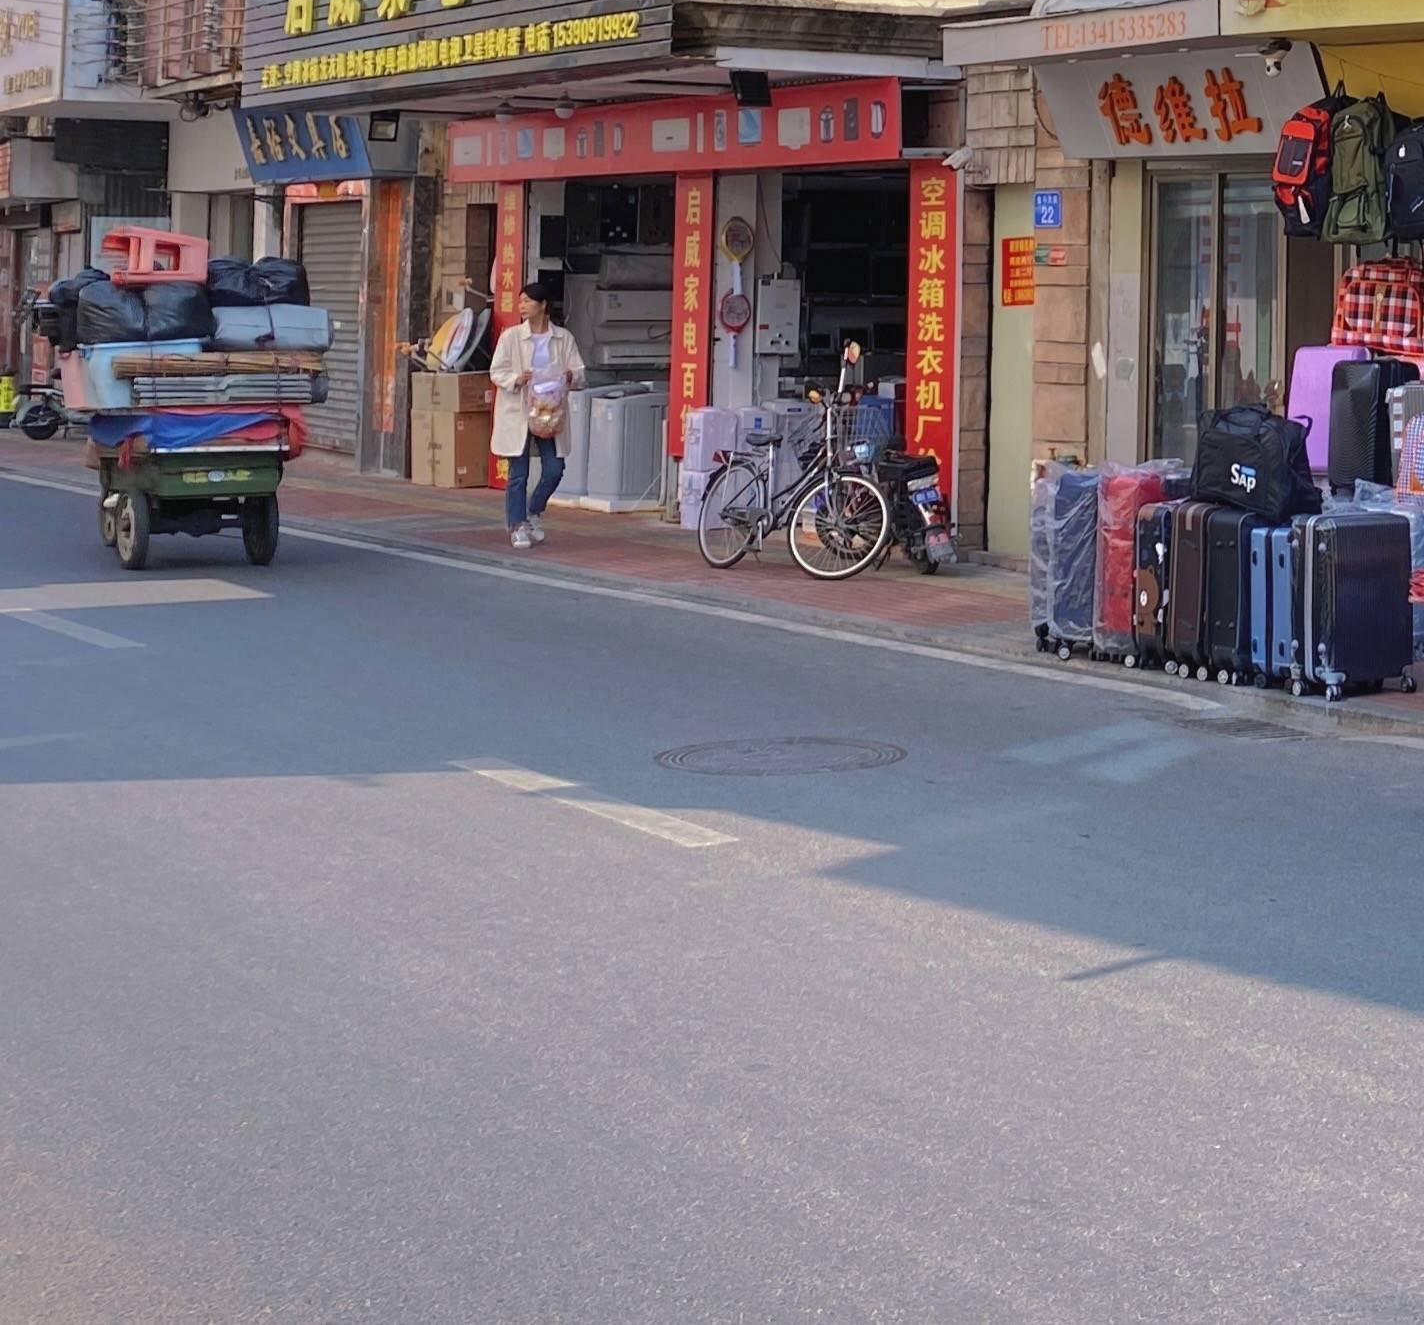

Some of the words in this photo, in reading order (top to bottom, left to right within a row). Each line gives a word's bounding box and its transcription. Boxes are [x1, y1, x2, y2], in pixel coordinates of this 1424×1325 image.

[524, 21, 551, 52] 电话
[1041, 11, 1187, 51] TEL:13415335283
[1096, 66, 1263, 148] 德维拉
[1041, 205, 1055, 224] 22
